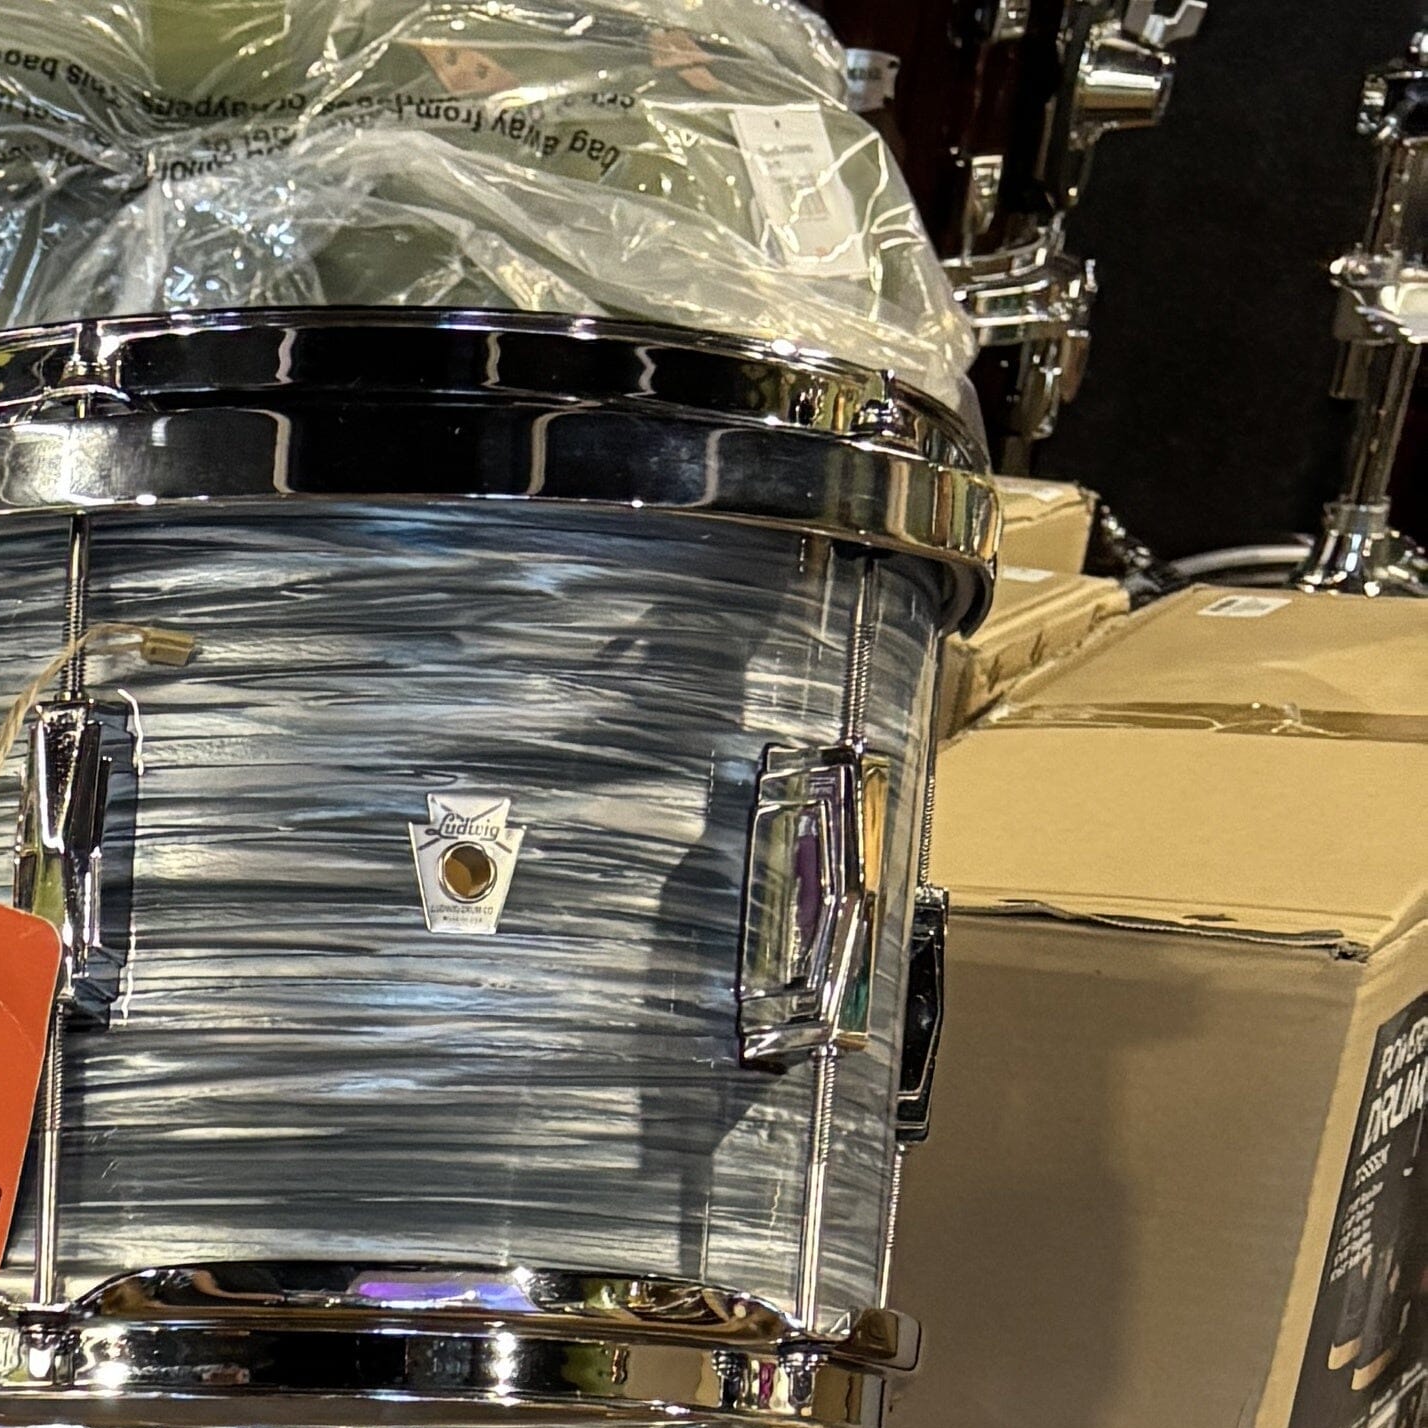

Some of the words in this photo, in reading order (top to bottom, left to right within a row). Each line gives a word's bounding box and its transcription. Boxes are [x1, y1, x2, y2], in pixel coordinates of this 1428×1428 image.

[415, 105, 482, 132] from
[490, 109, 561, 163] away
[567, 129, 620, 177] bag
[425, 813, 500, 841] Ludwig
